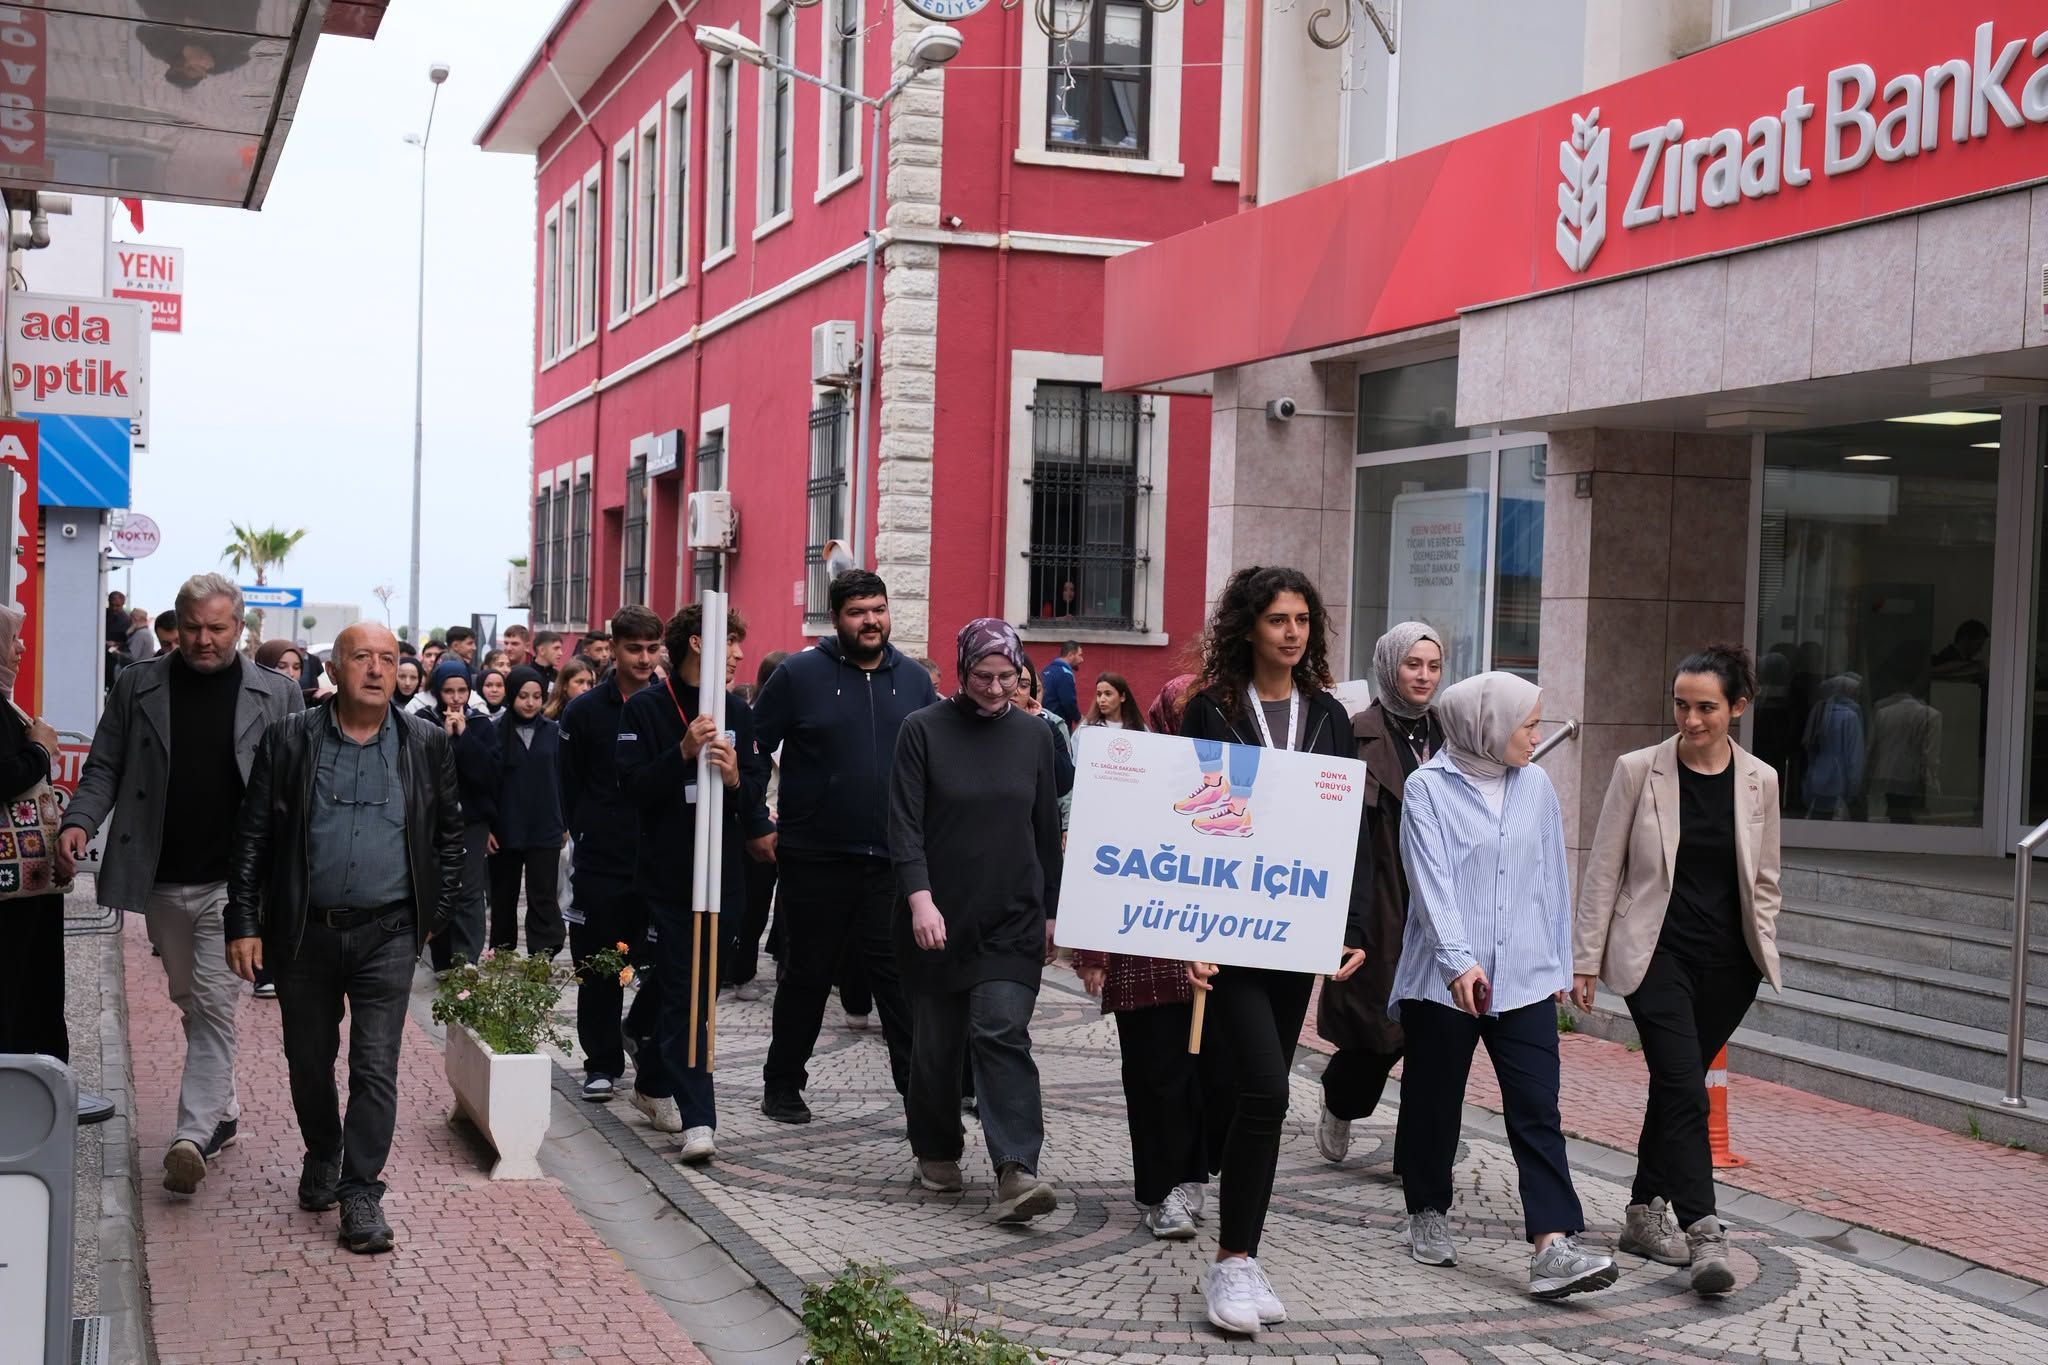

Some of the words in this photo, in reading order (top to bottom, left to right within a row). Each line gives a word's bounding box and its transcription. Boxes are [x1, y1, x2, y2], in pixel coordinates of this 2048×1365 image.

[1622, 86, 1815, 229] Ziraat
[21, 306, 110, 345] ada
[12, 359, 128, 401] optik
[117, 531, 155, 541] NOKTA
[1314, 781, 1352, 792] YÜRÜYÜŞ
[1320, 770, 1347, 780] DÜNYA
[1320, 792, 1343, 801] GÜNÜ
[1093, 844, 1243, 890] SAĞLIK
[1251, 855, 1329, 900] İÇİN
[1118, 900, 1291, 943] yürüyoruz
